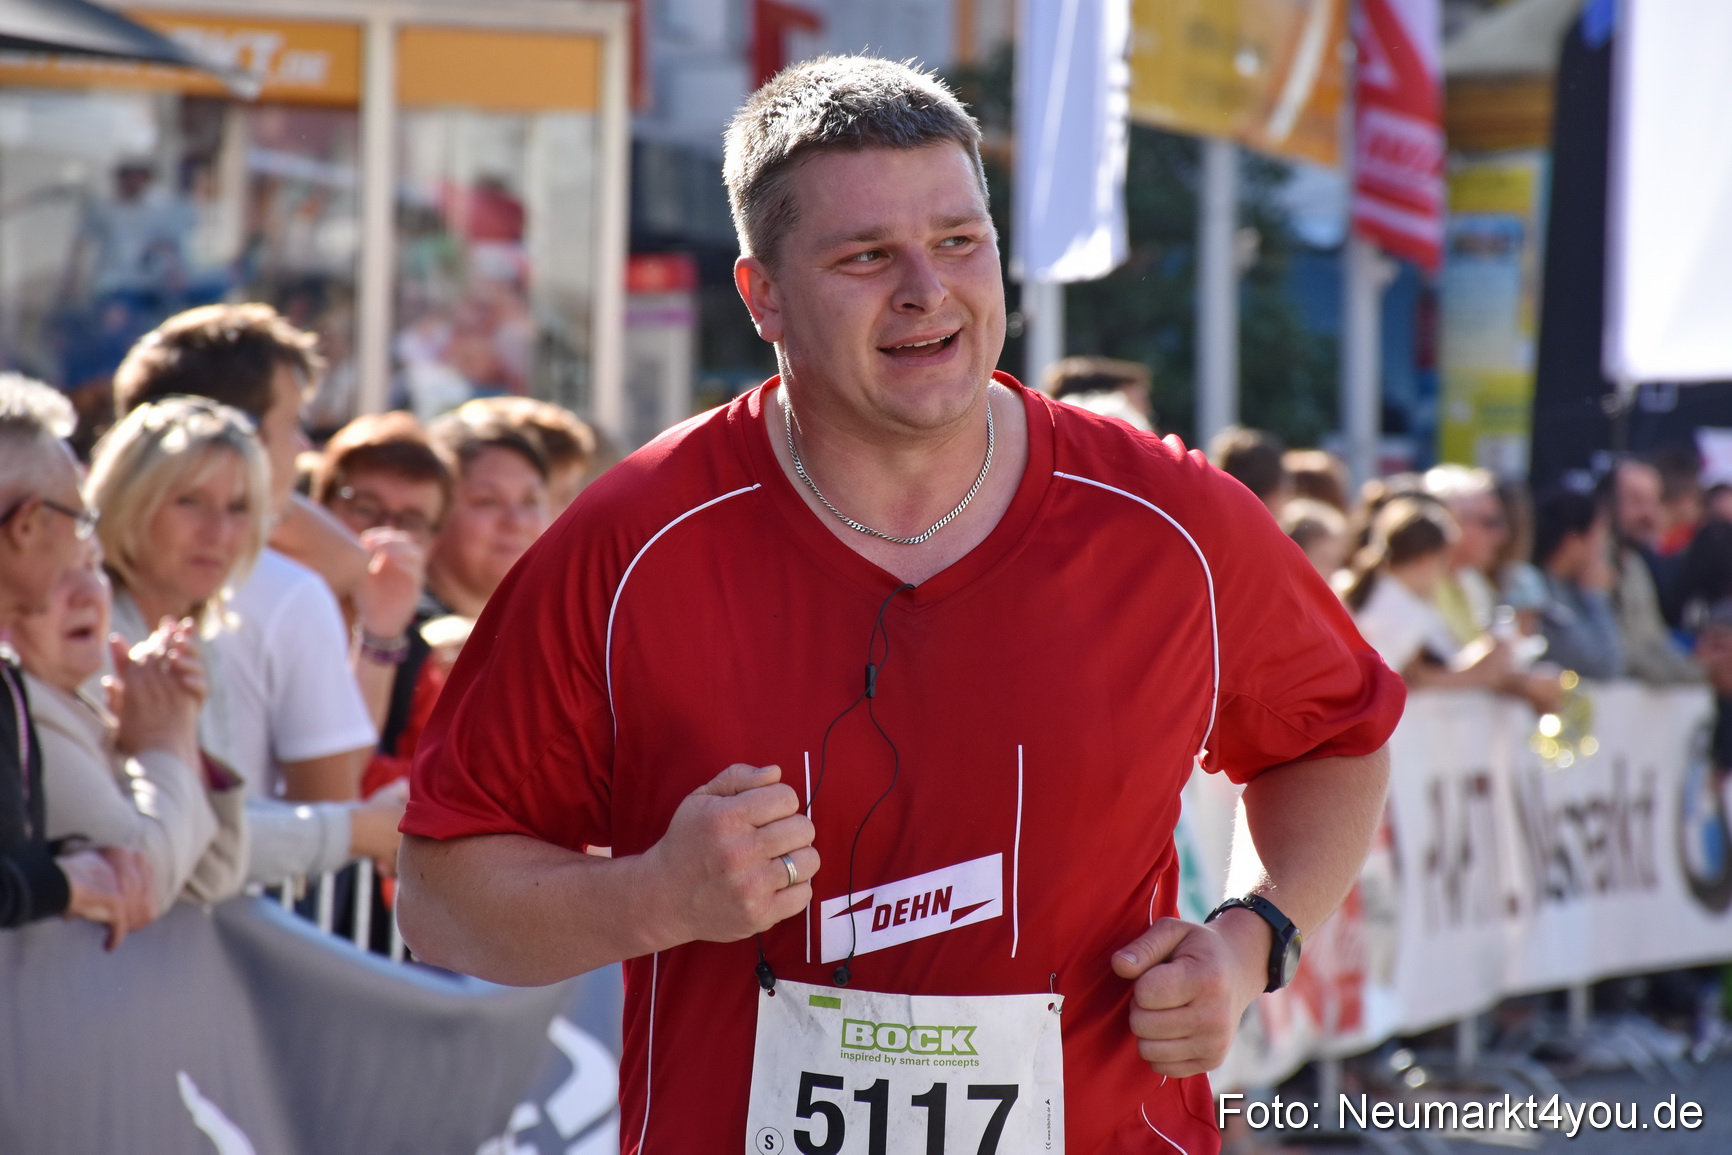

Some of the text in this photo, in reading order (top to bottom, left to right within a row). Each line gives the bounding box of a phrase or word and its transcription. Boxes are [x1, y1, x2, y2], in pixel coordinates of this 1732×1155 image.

[871, 885, 953, 932] DEHN
[841, 1018, 979, 1055] BOCK
[840, 1050, 980, 1068] inspired by smart concepts
[793, 1071, 1019, 1155] 5117
[764, 1134, 774, 1150] S
